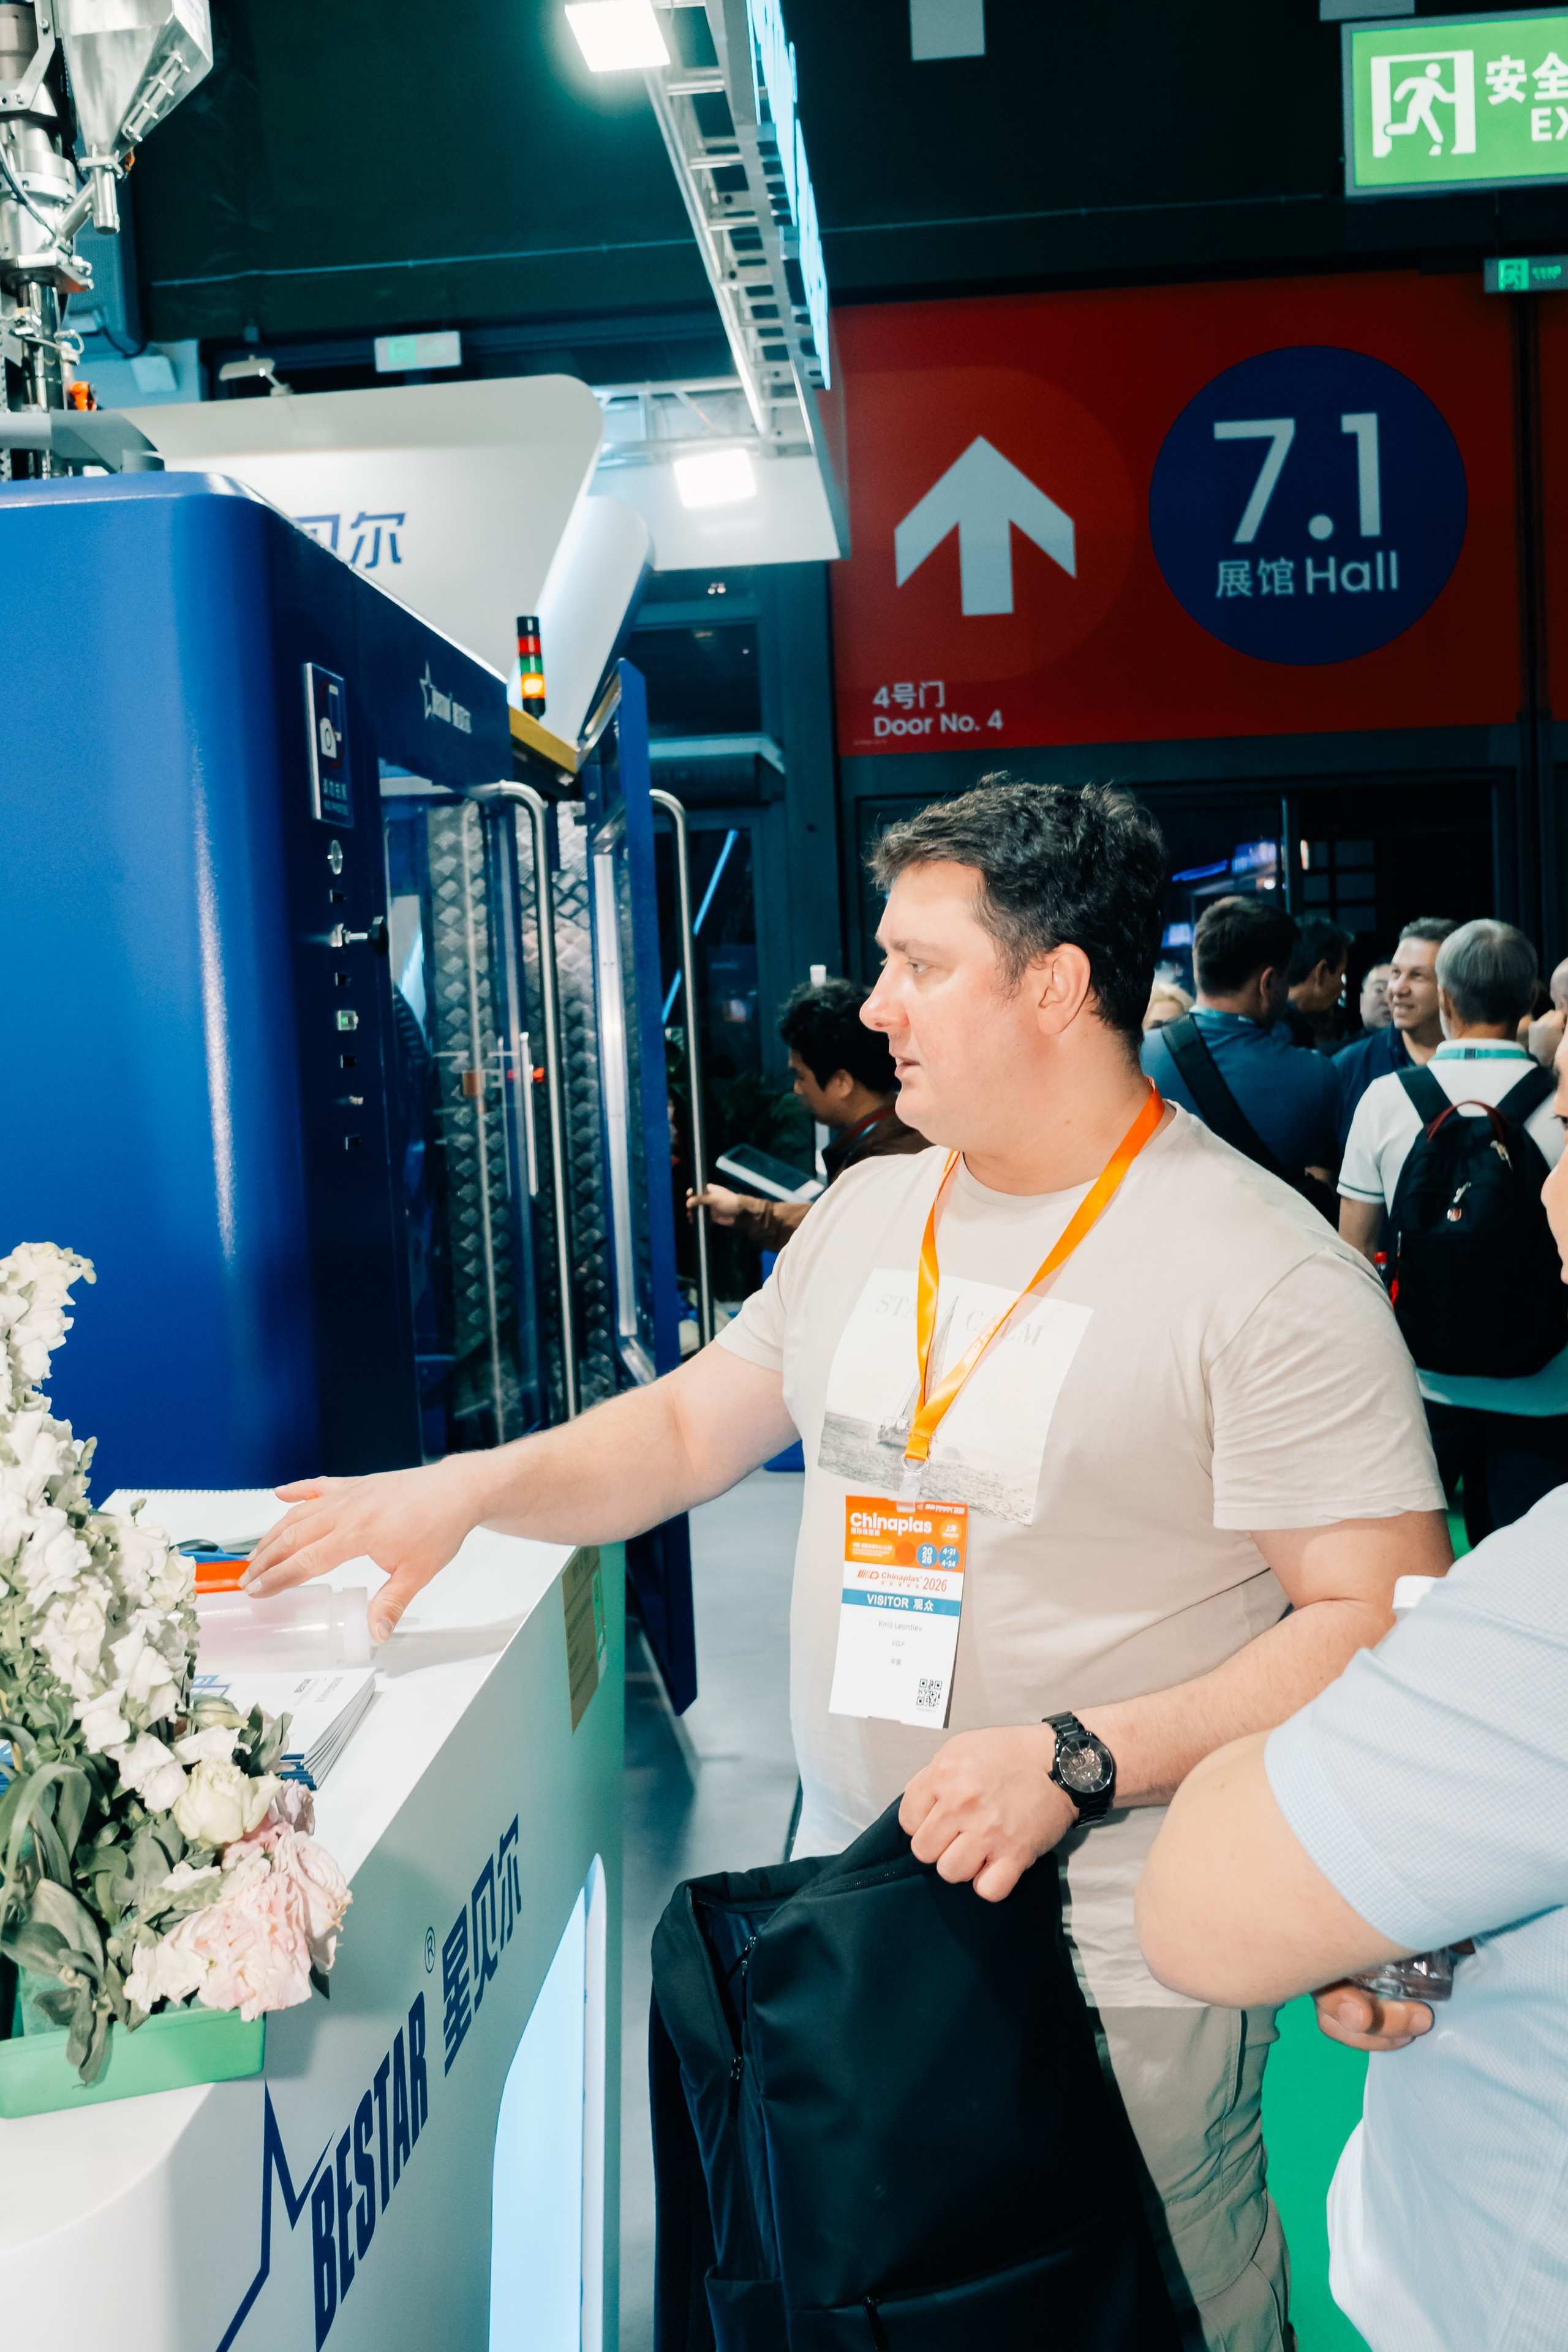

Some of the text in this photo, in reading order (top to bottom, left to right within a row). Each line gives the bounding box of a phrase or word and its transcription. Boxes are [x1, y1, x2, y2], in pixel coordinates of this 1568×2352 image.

[1485, 51, 1568, 105] 安全
[1213, 411, 1382, 544] 7.1
[1215, 549, 1398, 598] 展馆 Hall
[873, 680, 945, 709] 4号门
[873, 709, 1003, 737] Door No. 4
[850, 1512, 932, 1536] Chinaplas
[881, 1572, 919, 1583] Chinaplas
[923, 1577, 948, 1592] 2026
[867, 1594, 934, 1611] VISITOR 观众
[442, 1812, 521, 2078] 星贝尔
